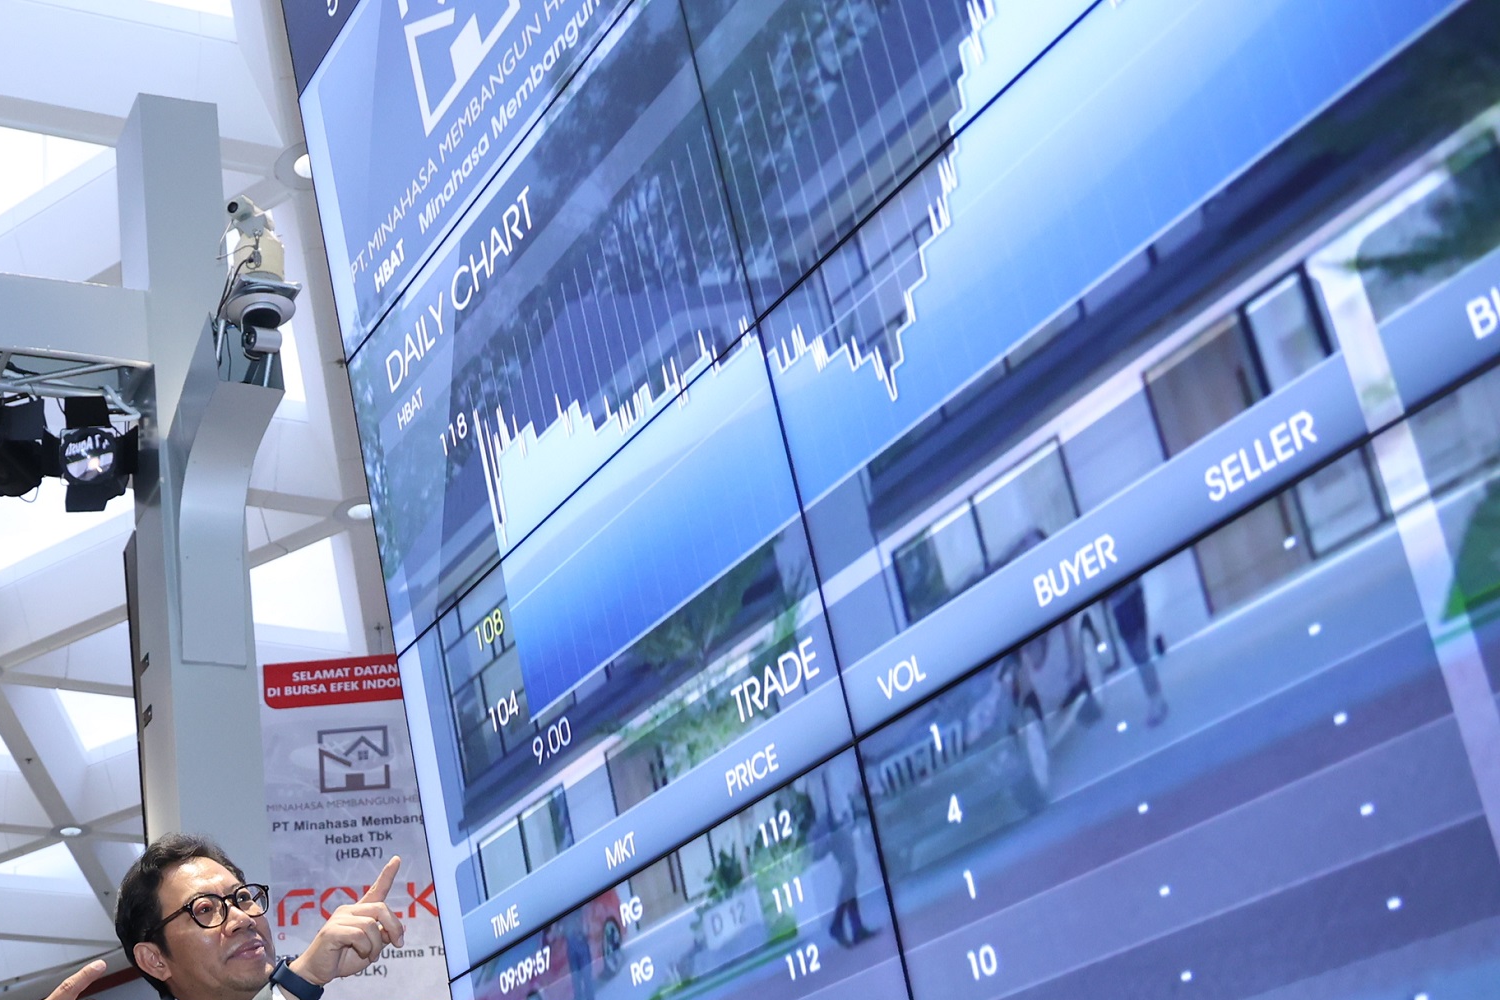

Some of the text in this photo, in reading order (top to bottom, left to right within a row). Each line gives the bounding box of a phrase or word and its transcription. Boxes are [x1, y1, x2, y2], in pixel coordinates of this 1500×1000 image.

[351, 257, 368, 283] PT.
[368, 157, 438, 255] MINAHASA
[438, 12, 542, 164] MEMBANGUN
[374, 238, 406, 293] HBAT
[419, 133, 489, 234] Minahasa
[385, 187, 533, 393] DAILY CHART
[397, 387, 425, 430] HBAT
[439, 412, 468, 456] 118
[474, 610, 504, 652] 108
[267, 687, 281, 697] DI
[284, 683, 327, 696] BURSA
[330, 681, 359, 693] EFEK
[292, 668, 351, 682] SELAMAT
[490, 905, 520, 939] TIME
[604, 831, 635, 870] MKT
[724, 743, 779, 796] PRICE
[876, 655, 926, 700] VOL
[1033, 534, 1118, 607] BUYER
[1204, 411, 1317, 503] SELLER
[731, 637, 820, 723] TRADE
[488, 691, 519, 733] 104
[531, 716, 572, 765] 9.00
[266, 801, 323, 812] MINAHASA
[327, 796, 401, 808] MEMBANGUN
[272, 822, 290, 832] PT
[293, 818, 357, 831] Minahasa
[325, 830, 393, 845] Hebat Tbk
[335, 846, 383, 862] (HBAT)
[499, 723, 942, 994] 09:09:57 RG 112 1
[630, 956, 654, 987] RG
[771, 877, 804, 914] 111
[947, 794, 962, 824] 4
[785, 944, 821, 981] 112
[963, 870, 976, 899] 1
[381, 946, 424, 960] Utama
[967, 945, 998, 980] 10
